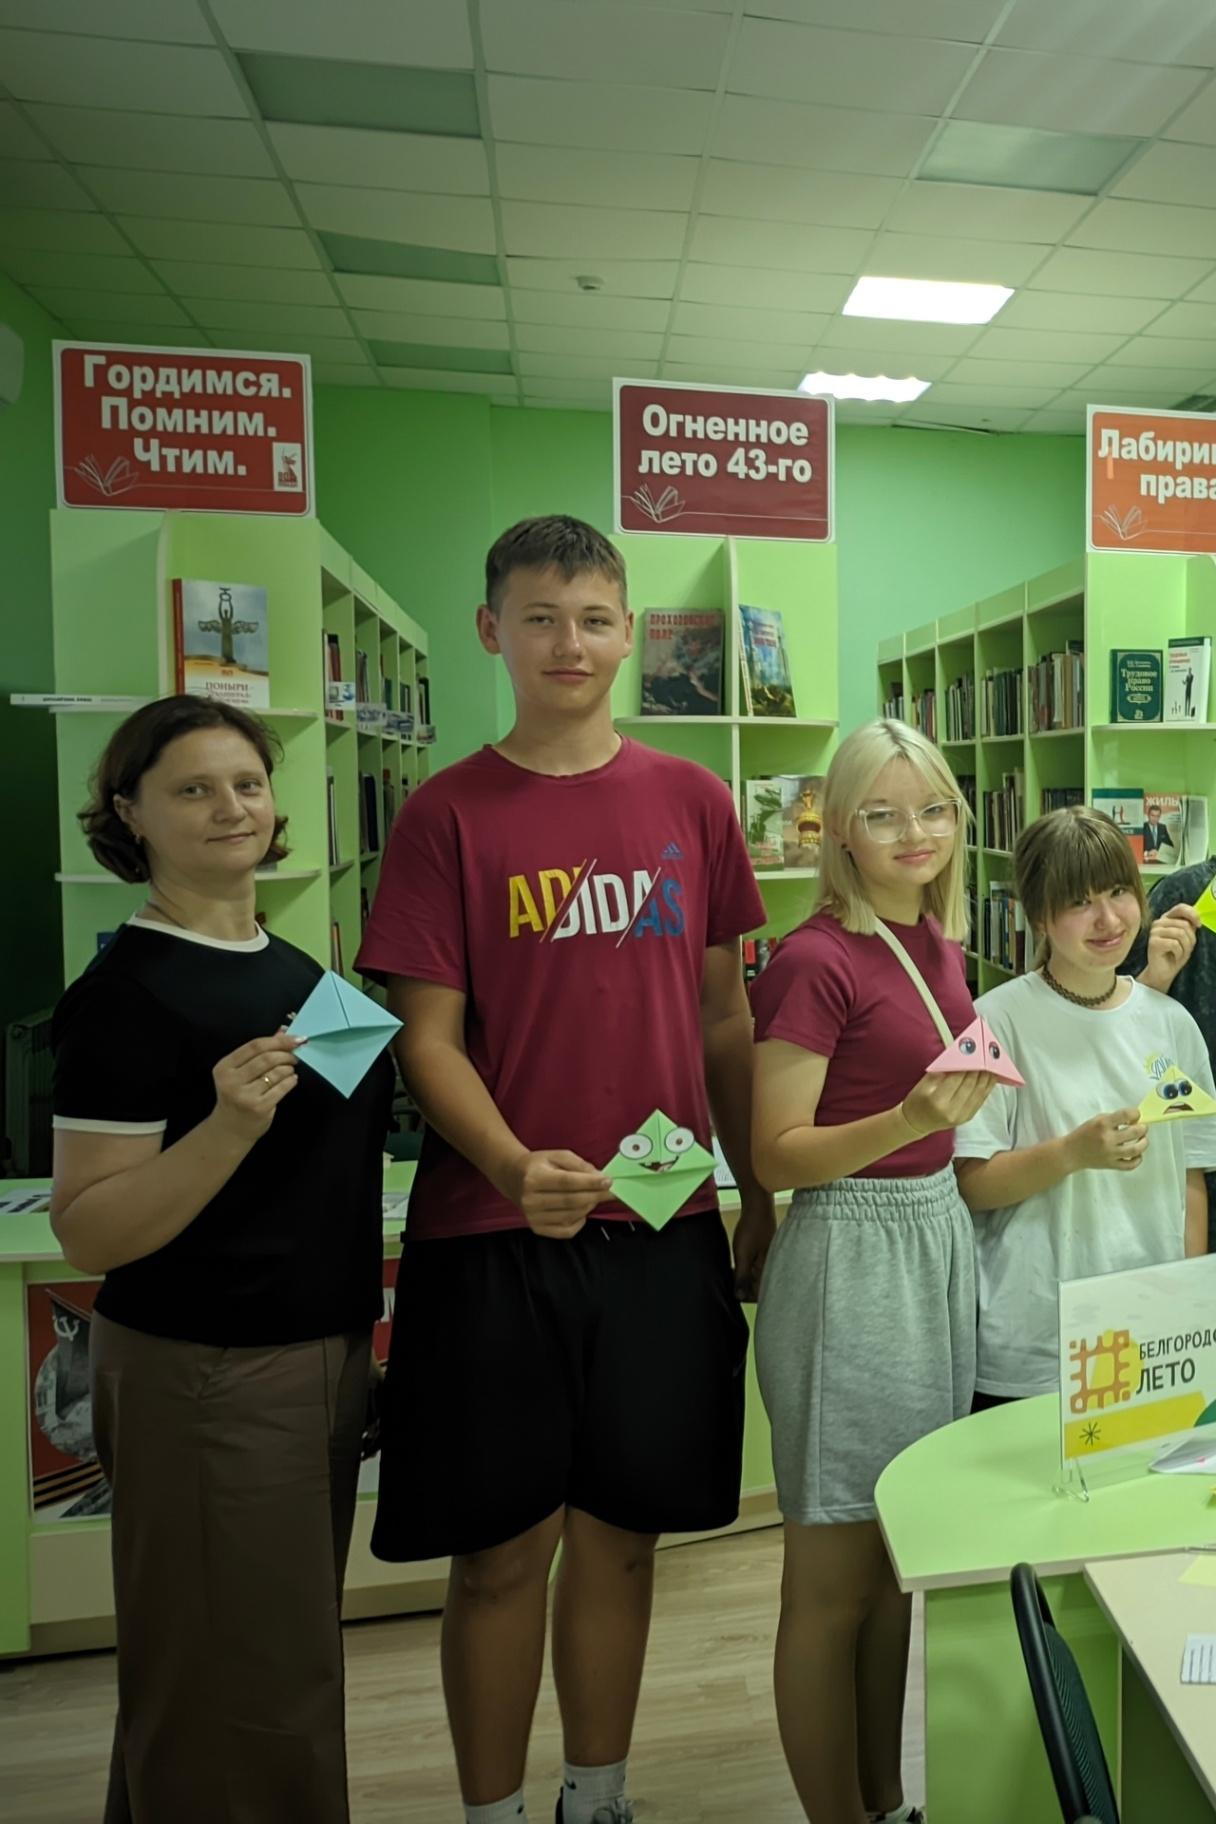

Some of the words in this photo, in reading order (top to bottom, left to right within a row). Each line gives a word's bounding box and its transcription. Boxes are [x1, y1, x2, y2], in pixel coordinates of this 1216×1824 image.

[84, 354, 292, 399] Гордимся.
[101, 396, 277, 437] Помним.
[642, 404, 809, 446] Огненное
[133, 438, 247, 476] Чтим.
[638, 449, 718, 478] лето
[726, 447, 813, 483] 43-го
[508, 865, 685, 941] ADIDAS
[1136, 1358, 1196, 1395] ЛЕТО
